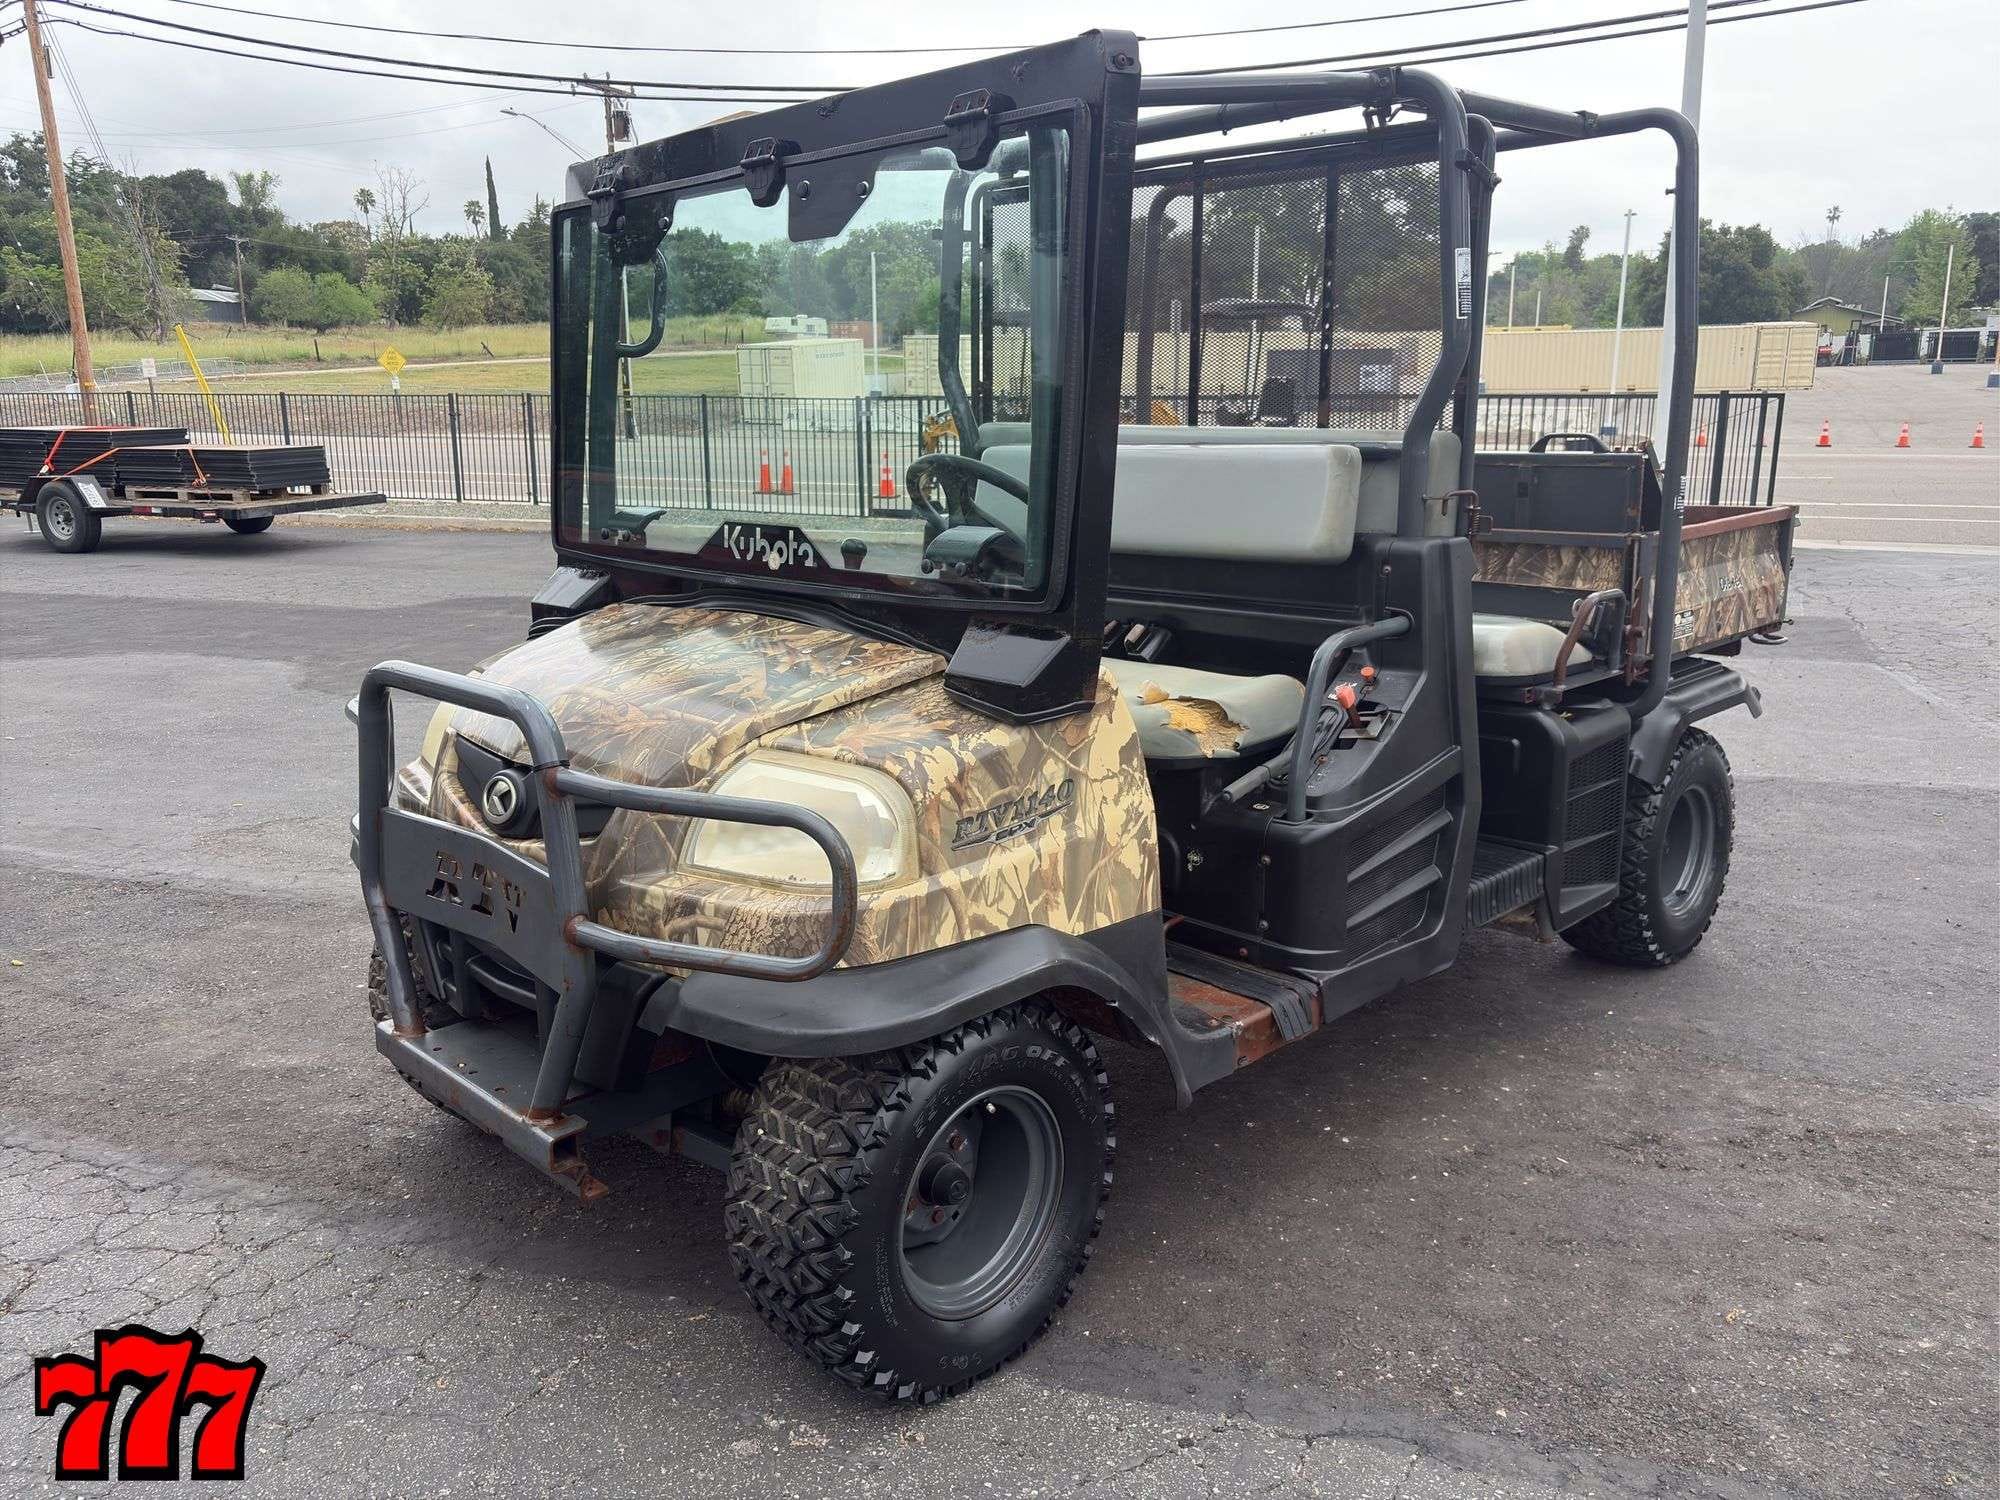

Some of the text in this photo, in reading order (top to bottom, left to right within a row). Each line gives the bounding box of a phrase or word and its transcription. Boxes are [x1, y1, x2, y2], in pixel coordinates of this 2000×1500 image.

[723, 524, 815, 568] Kubota
[952, 778, 1075, 843] RTV1140
[425, 850, 527, 934] RTV
